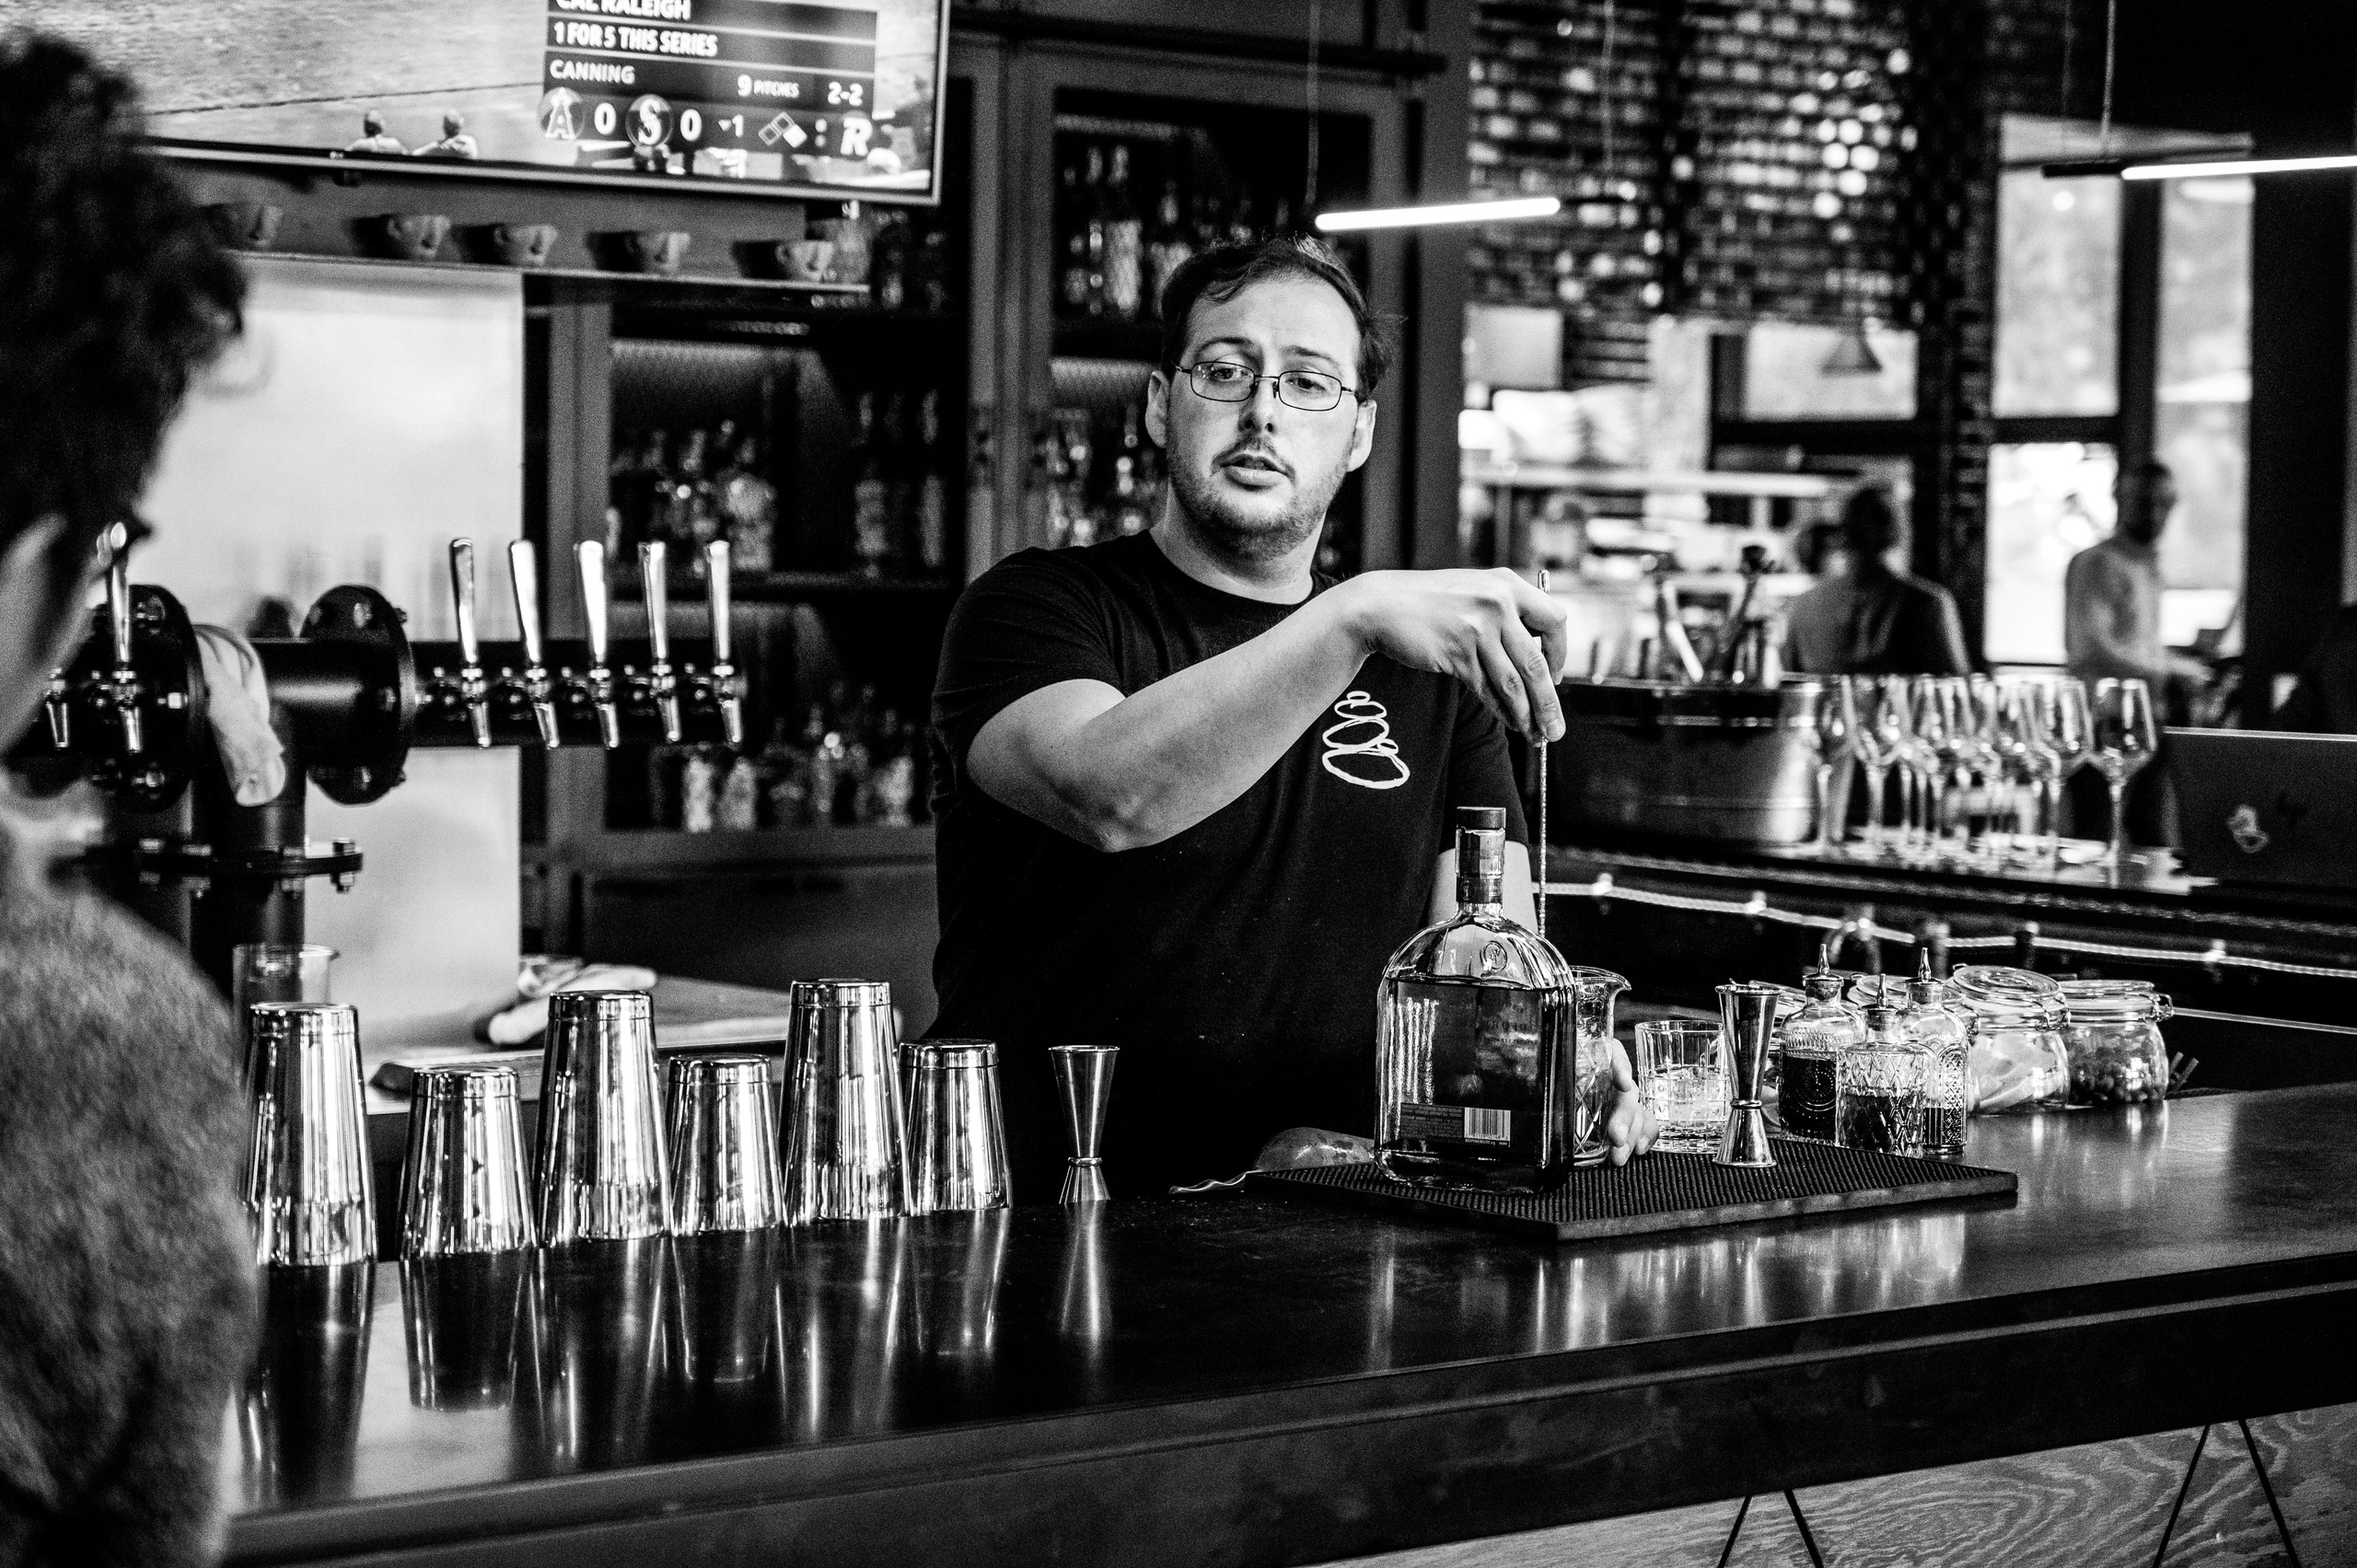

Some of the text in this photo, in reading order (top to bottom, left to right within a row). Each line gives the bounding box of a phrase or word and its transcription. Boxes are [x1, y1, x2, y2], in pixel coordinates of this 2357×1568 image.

[601, 0, 691, 20] RALEIGH
[554, 21, 718, 57] 1 FOR 5 THIS SERIES
[550, 60, 635, 85] CANNING
[737, 75, 799, 99] 9 PITCHES
[828, 81, 863, 106] 2-2
[594, 102, 616, 134] 0
[679, 109, 702, 141] 0
[731, 114, 744, 137] 1
